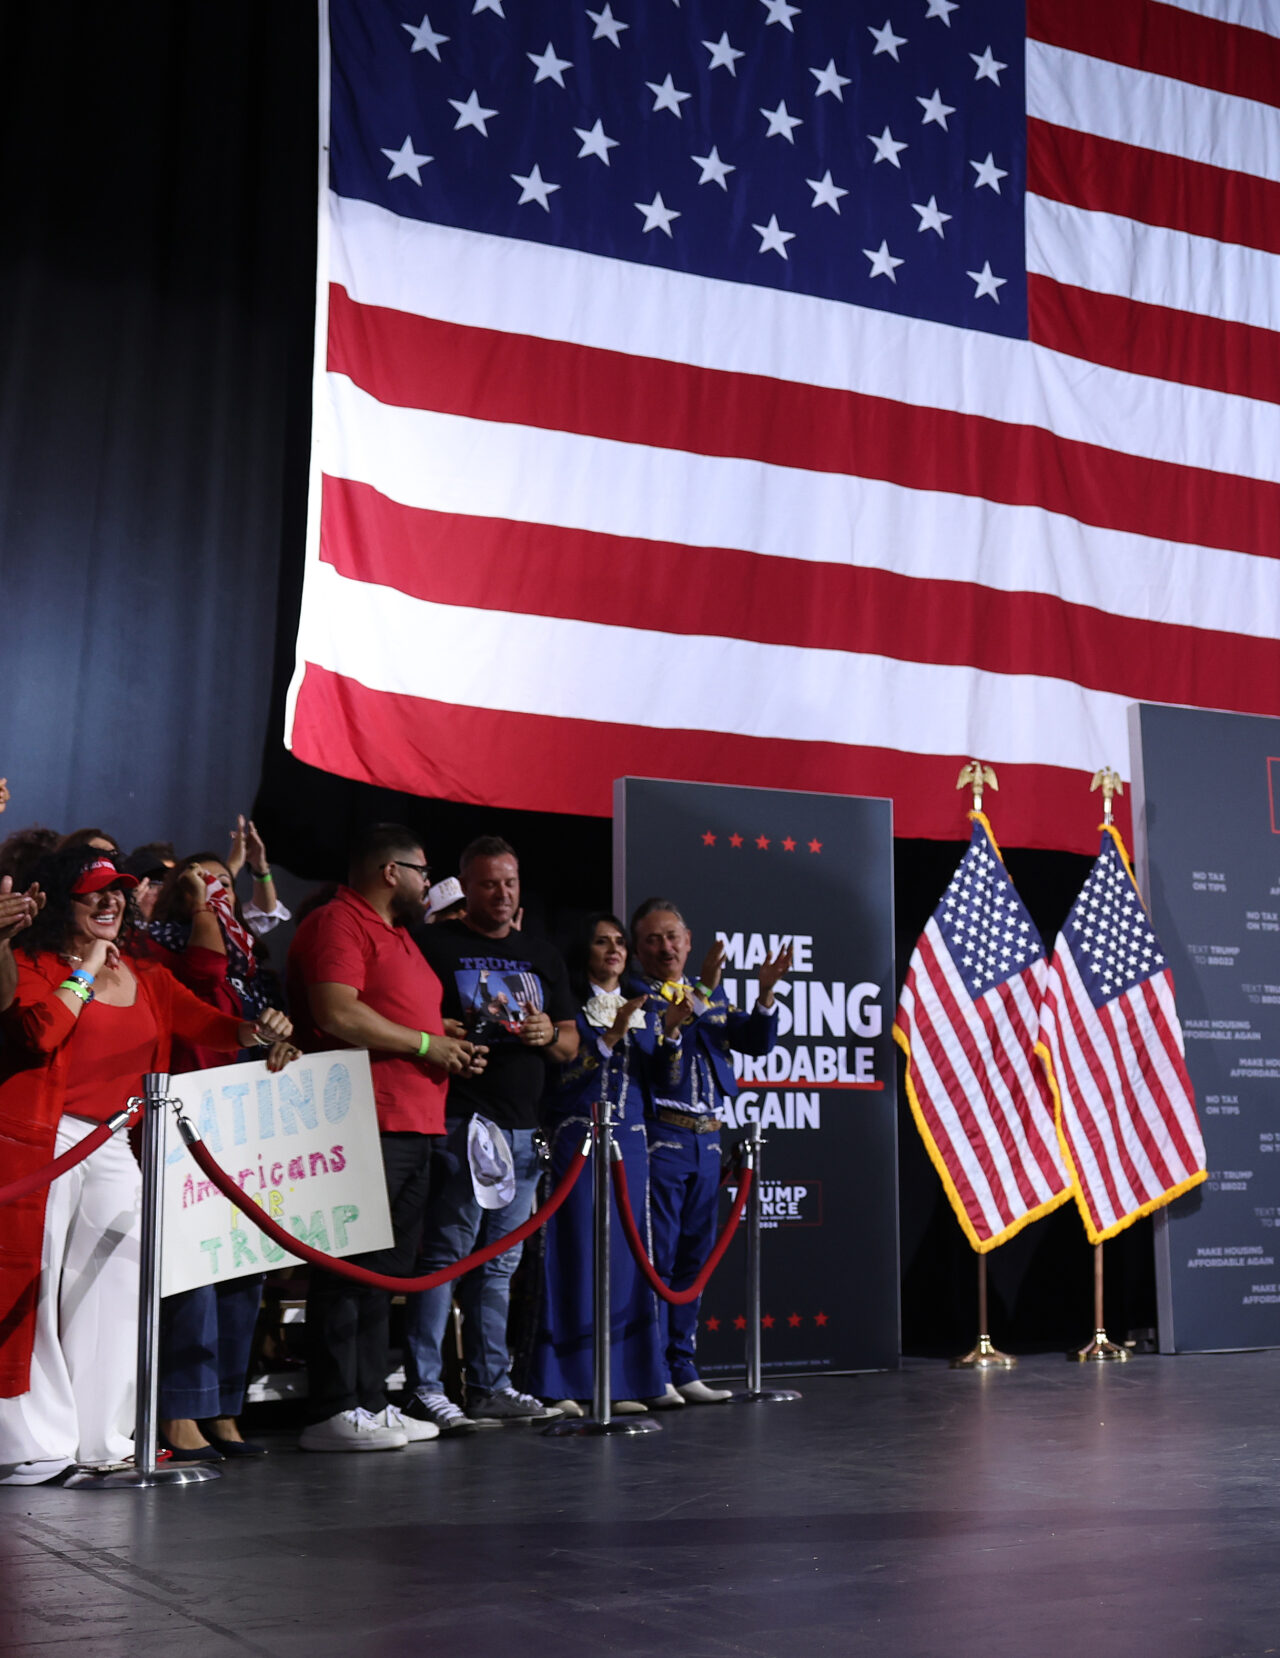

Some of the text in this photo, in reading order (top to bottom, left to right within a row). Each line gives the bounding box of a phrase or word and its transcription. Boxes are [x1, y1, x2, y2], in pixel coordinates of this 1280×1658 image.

[1192, 872, 1225, 882] NO TAX
[1192, 882, 1227, 892] ON TIPS
[1246, 912, 1278, 921] NO TAX
[1246, 922, 1280, 931] ON TIPS
[459, 957, 532, 971] TRUMP
[723, 978, 882, 1038] USING
[1186, 1020, 1251, 1029] MAKE HOUSING
[1183, 1031, 1261, 1040] FFORDABLE AGAIN
[1239, 1059, 1264, 1067] MAKE
[1206, 1096, 1238, 1104] NO TAX
[165, 1063, 352, 1165] ATINO
[1206, 1106, 1240, 1114] ON TIPS
[1260, 1144, 1273, 1152] ON
[727, 1186, 807, 1203] TUMP
[1197, 1246, 1264, 1257] MAKE HOUSING
[1188, 1257, 1274, 1268] AFFORDABLE AGAIN
[1252, 1284, 1276, 1293] MAKE
